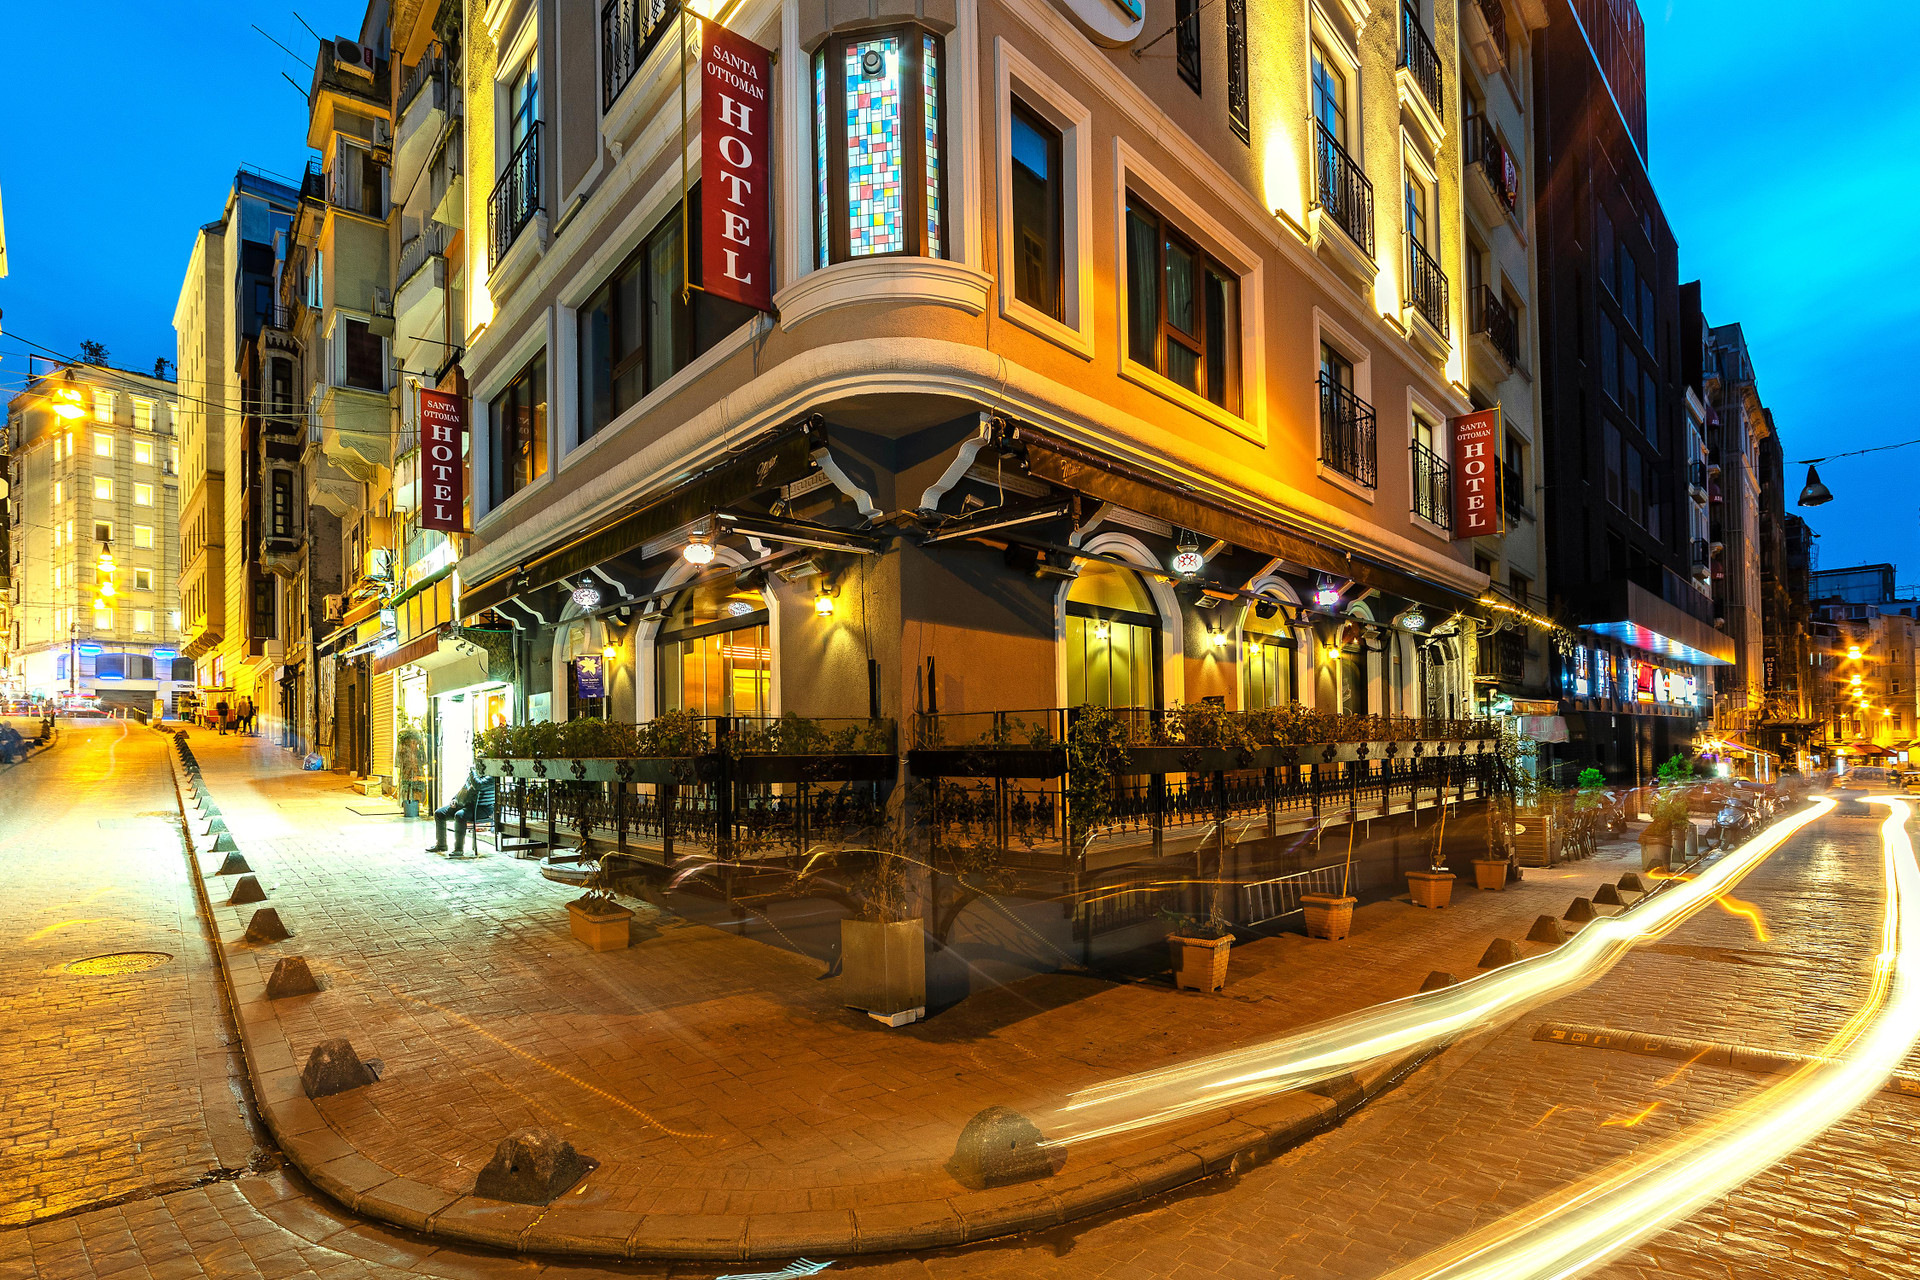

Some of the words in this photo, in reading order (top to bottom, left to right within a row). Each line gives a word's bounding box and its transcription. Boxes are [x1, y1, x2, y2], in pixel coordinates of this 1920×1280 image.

[713, 45, 758, 80] SANTA
[707, 62, 764, 100] OTTOMAN
[718, 92, 753, 285] HOTEL
[423, 410, 460, 422] OTTOMAN
[427, 400, 456, 413] SANTA
[1457, 429, 1492, 442] OTTOMAN
[1460, 421, 1487, 432] SANTA
[431, 424, 453, 521] HOTEL
[1464, 442, 1486, 528] HOTEL
[1766, 662, 1774, 687] HOTEL
